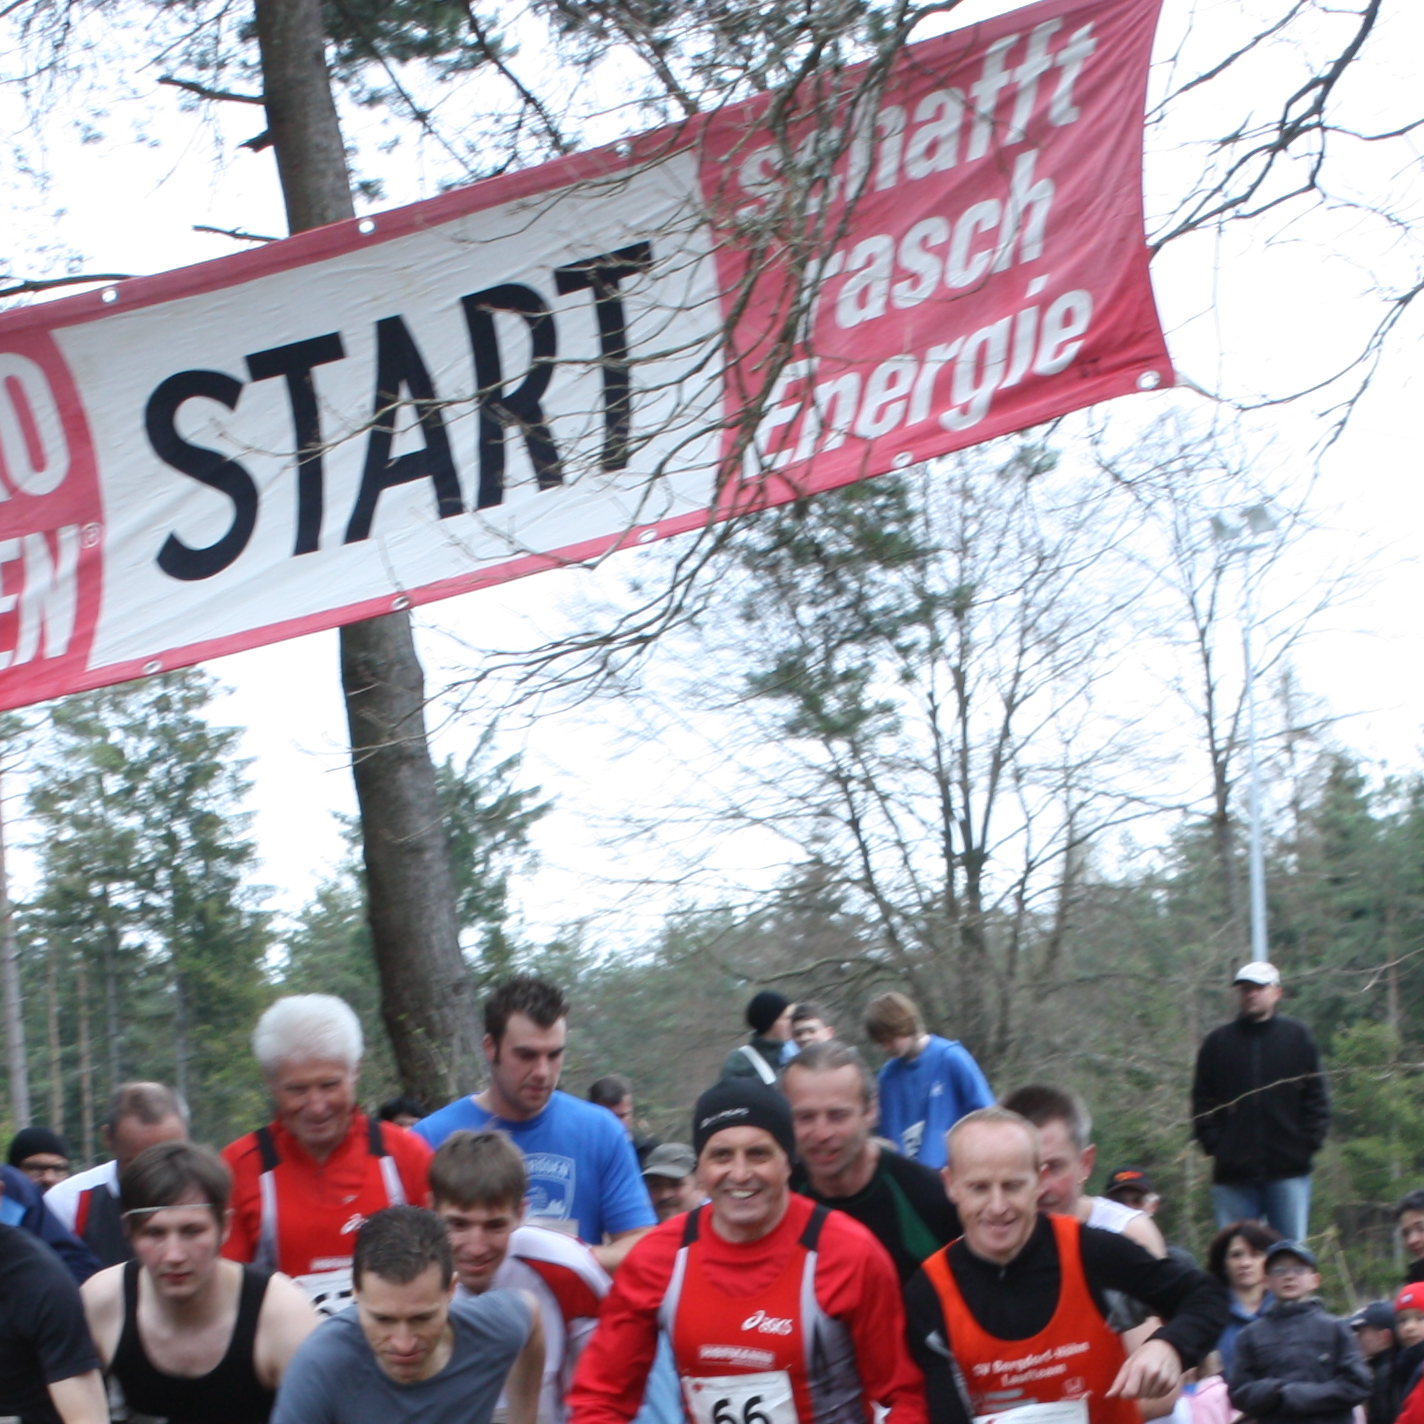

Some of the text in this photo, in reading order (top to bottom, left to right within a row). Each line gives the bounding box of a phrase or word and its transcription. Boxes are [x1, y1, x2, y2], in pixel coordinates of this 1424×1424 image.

[792, 148, 1056, 345] rasch
[145, 240, 653, 582] START
[743, 275, 1093, 479] Energie
